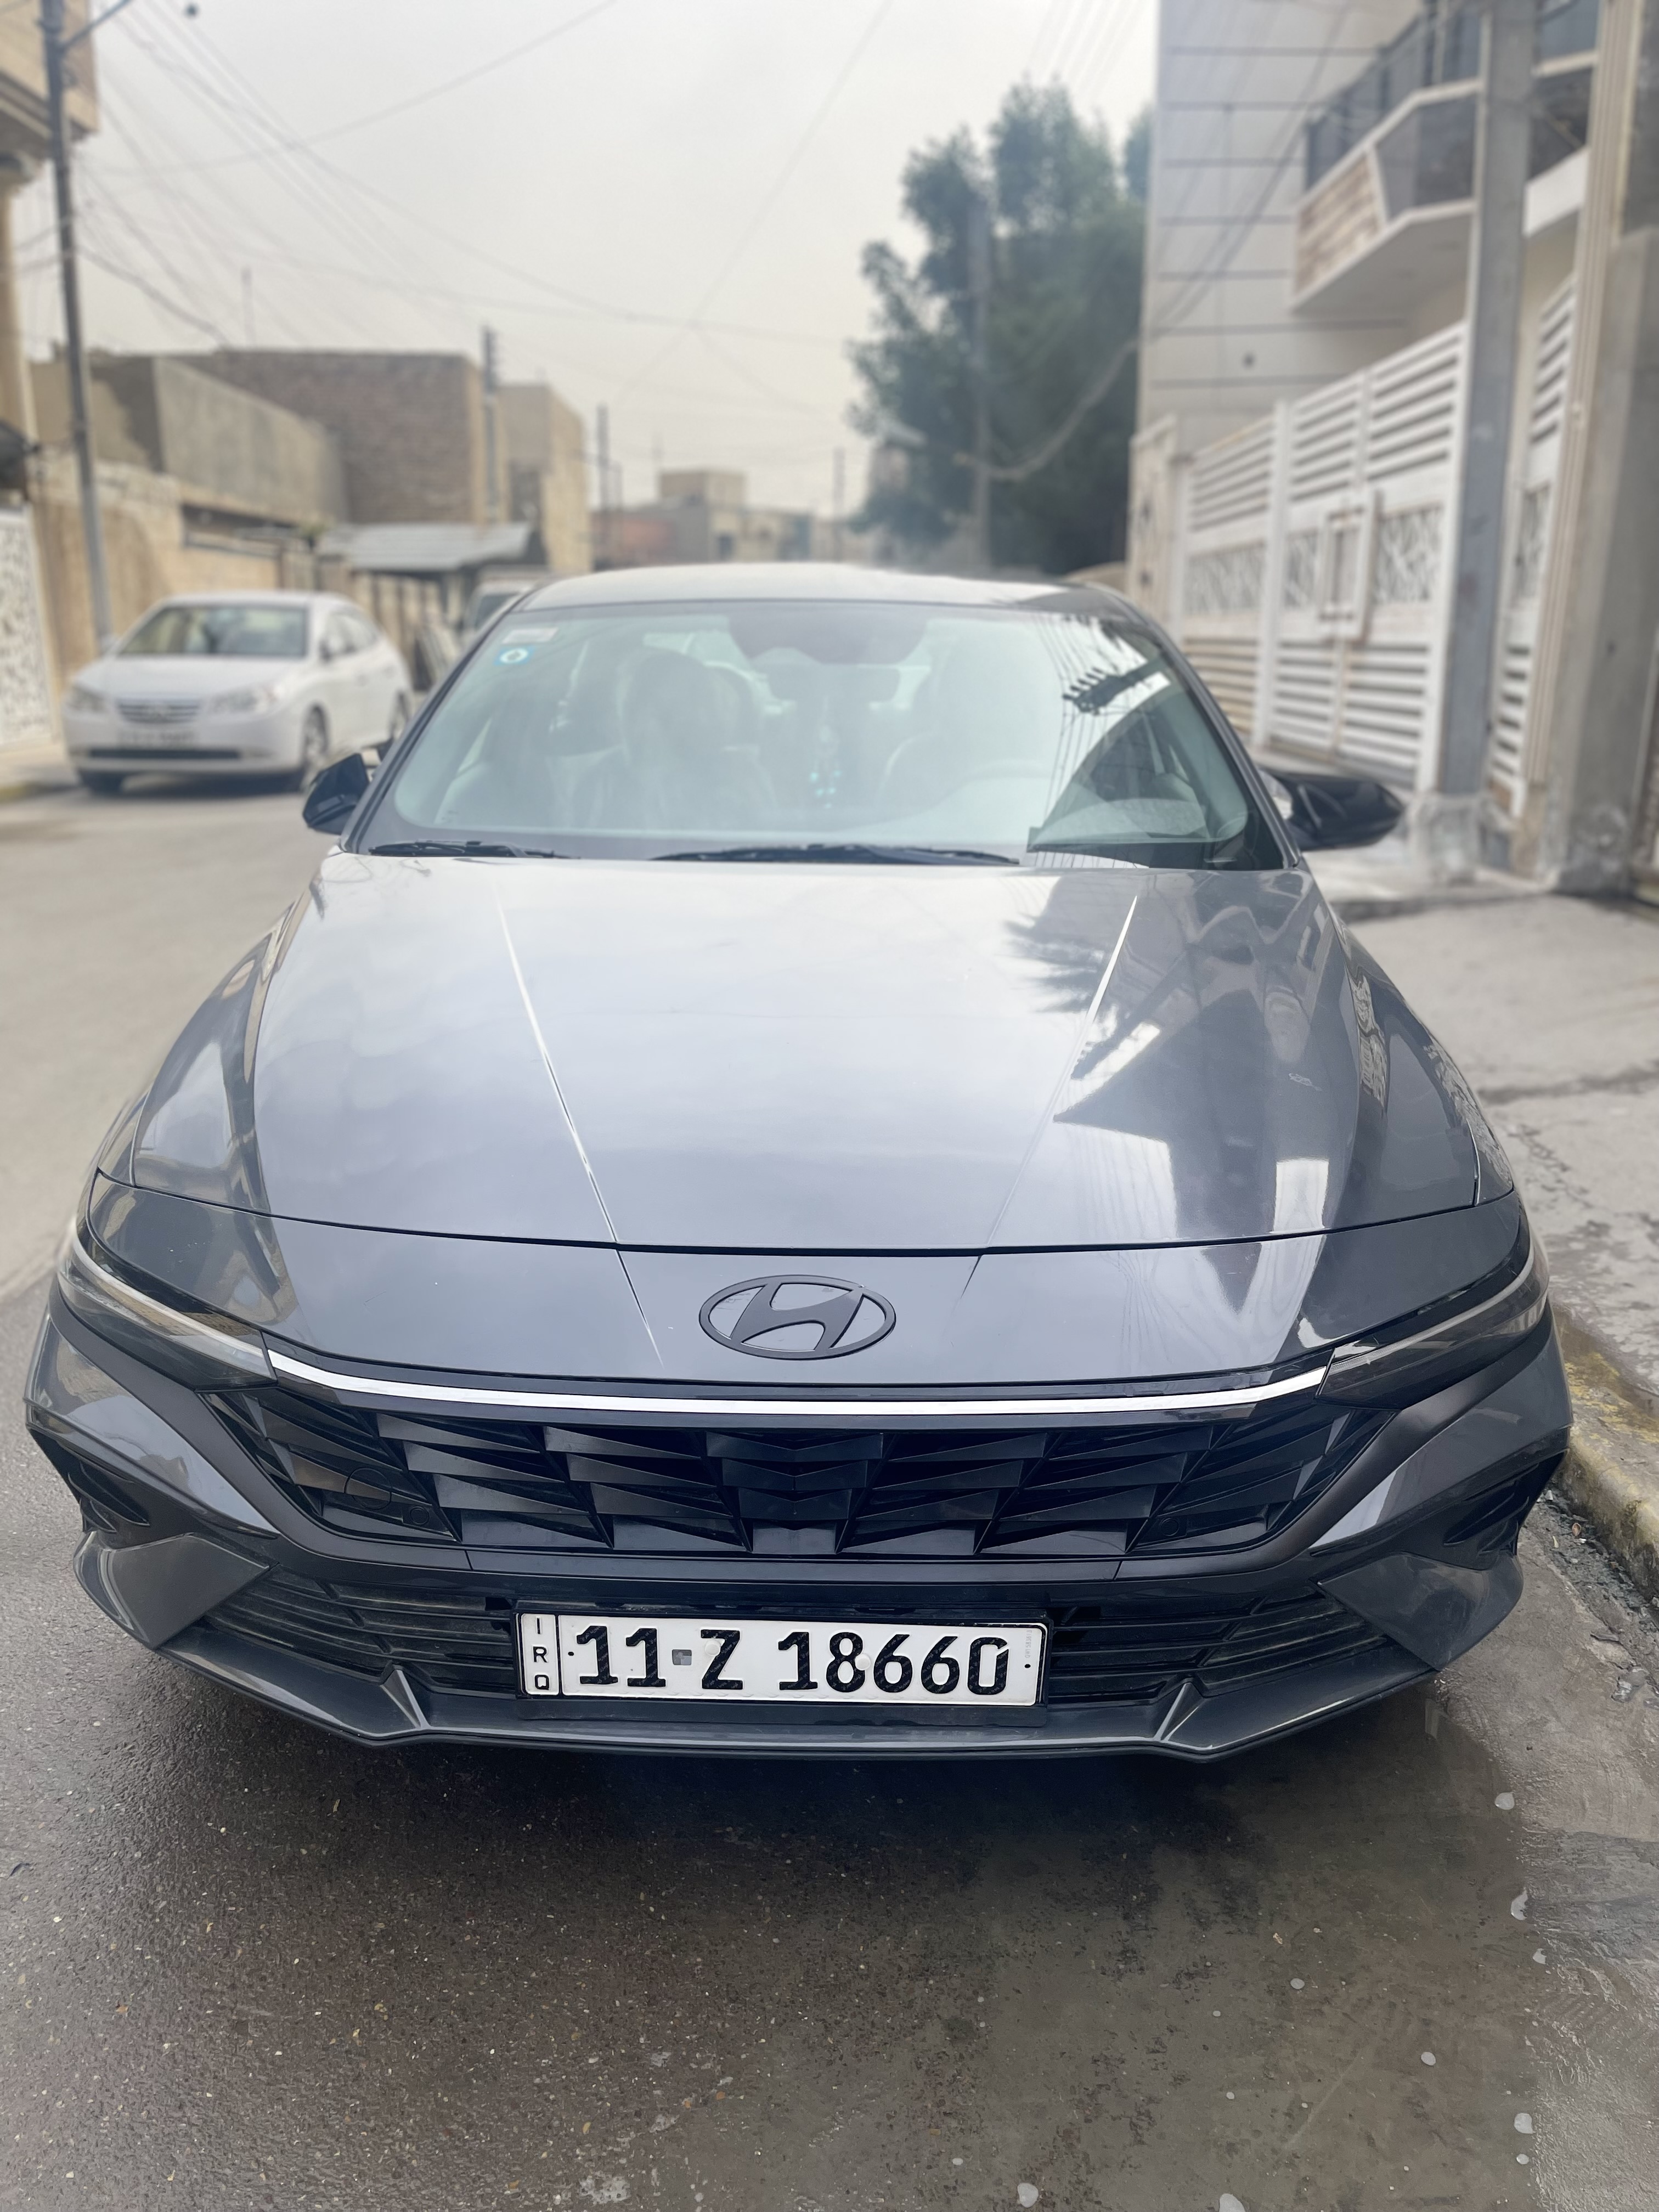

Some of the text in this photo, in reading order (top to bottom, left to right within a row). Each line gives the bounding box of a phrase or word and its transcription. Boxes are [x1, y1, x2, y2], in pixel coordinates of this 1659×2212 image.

[577, 1626, 1009, 1695] 11 Z 18660
